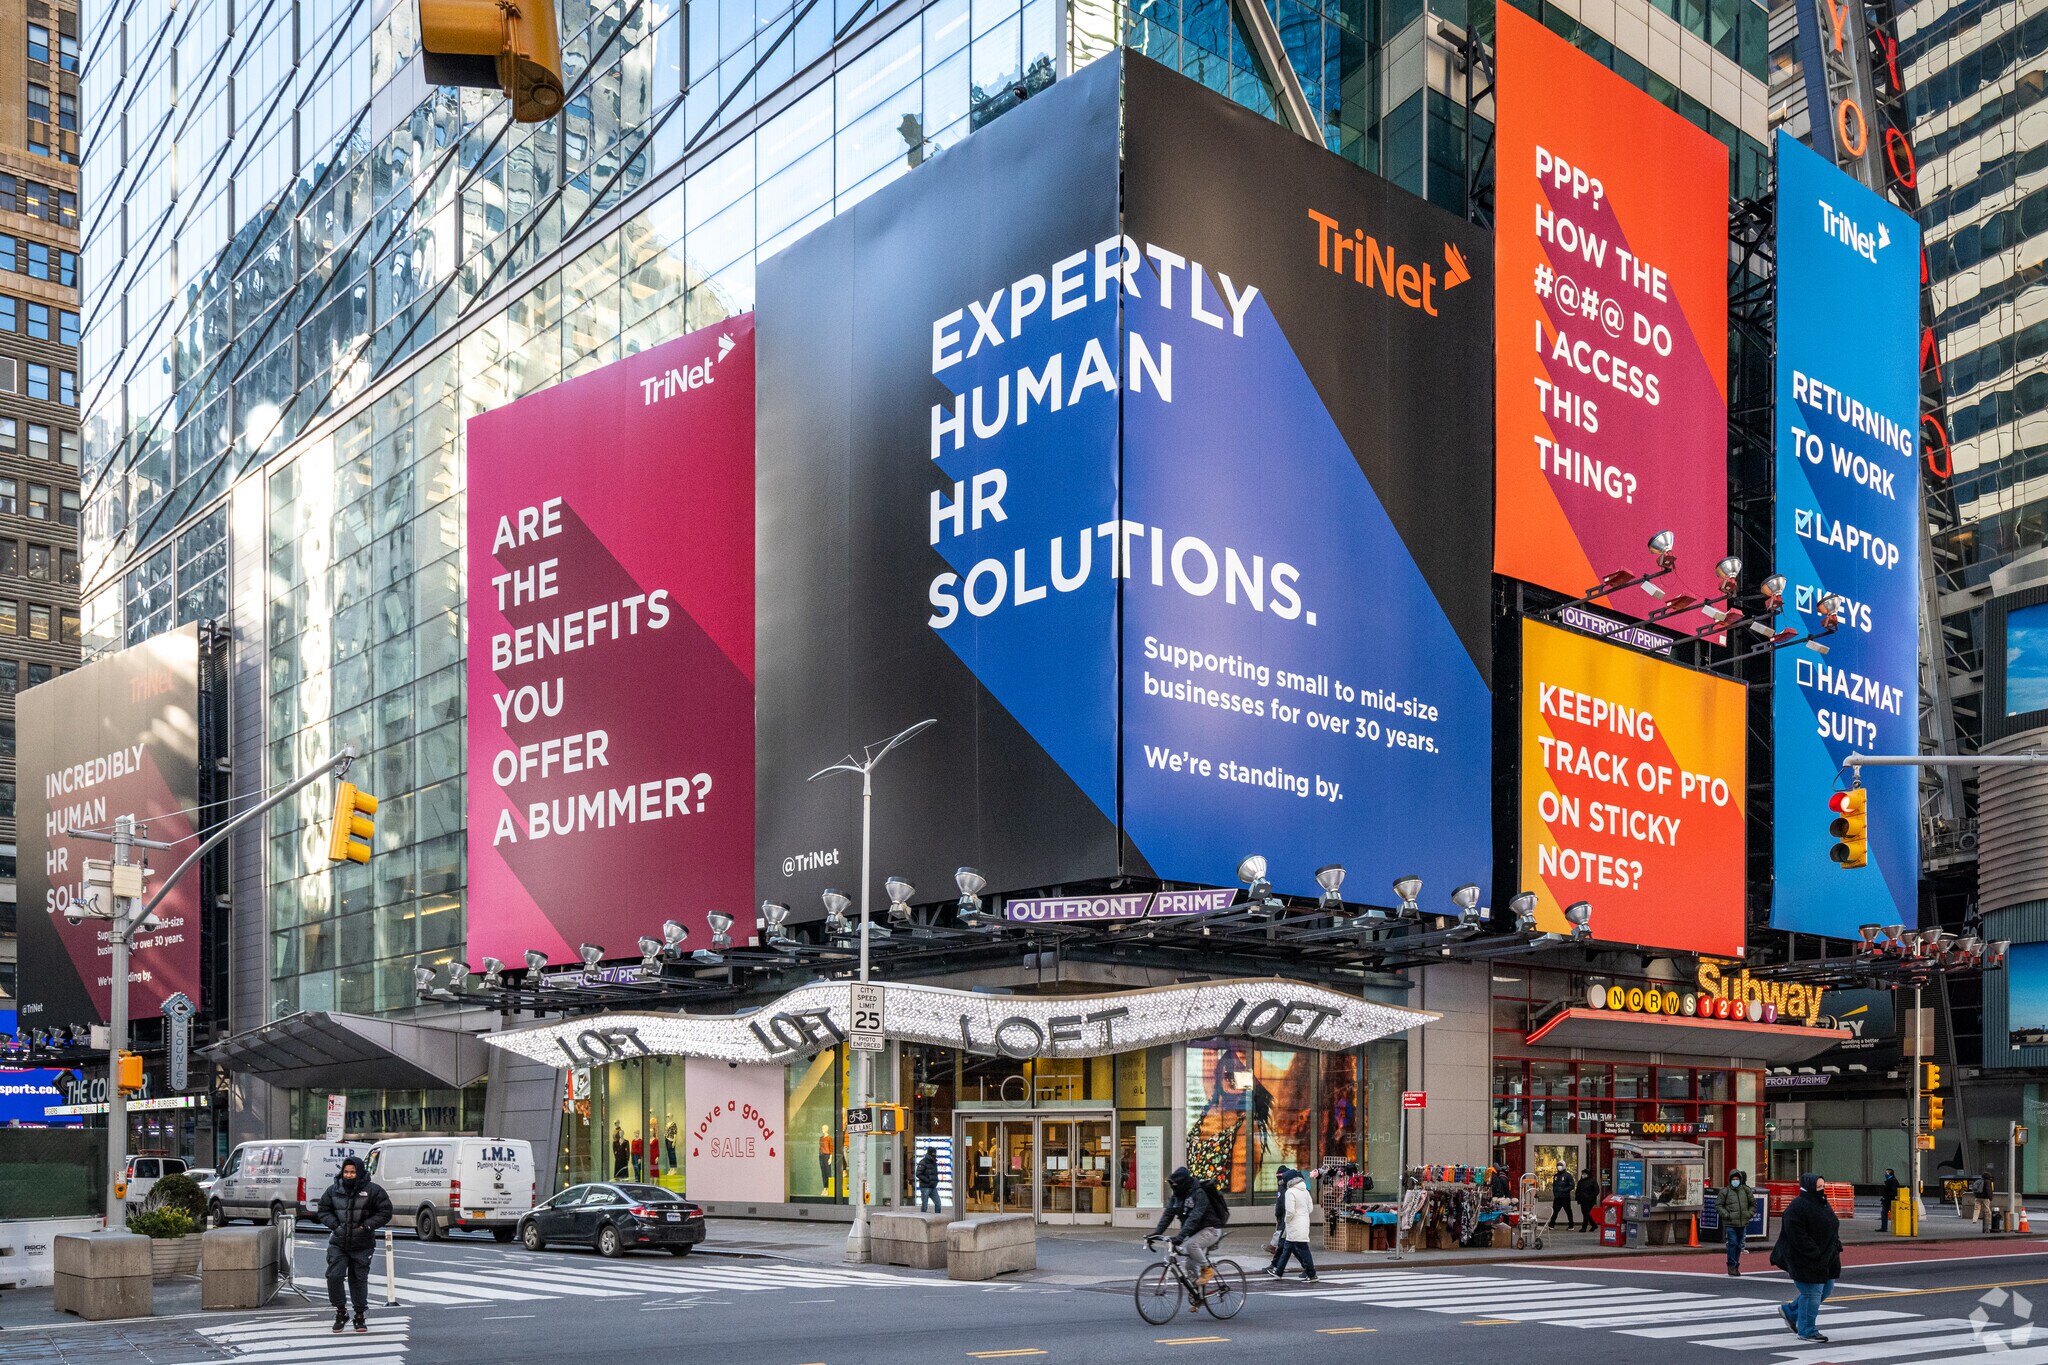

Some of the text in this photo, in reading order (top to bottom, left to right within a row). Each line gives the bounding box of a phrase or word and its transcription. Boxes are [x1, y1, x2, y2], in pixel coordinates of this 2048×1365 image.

[1536, 145, 1604, 211] PPP?
[1535, 203, 1667, 303] HOW THE
[1818, 199, 1877, 264] TriNet
[1308, 208, 1438, 317] TriNet
[931, 234, 1259, 374] EXPERTLY
[1534, 263, 1672, 357] #@#@ DO
[640, 357, 714, 405] TriNet
[1535, 320, 1660, 405] I ACCESS
[931, 331, 1172, 460] HUMAN
[1534, 377, 1598, 433] THIS
[1792, 370, 1912, 457] RETURNING
[1534, 435, 1637, 504] THING?
[1791, 426, 1895, 501] TO WORK
[492, 496, 562, 555] ARE
[930, 468, 1008, 545] HR
[1816, 512, 1899, 570] LAPTOP
[492, 558, 558, 611] THE
[927, 519, 1317, 629] SOLUTIONS.
[492, 589, 670, 671] BENEFITS
[1638, 633, 1669, 652] PRIME
[493, 677, 563, 727] YOU
[1144, 636, 1438, 722] Supporting small to mid-size
[1818, 663, 1903, 716] HAZMAT
[1144, 672, 1439, 754] businesses for over 30 years.
[1539, 682, 1654, 741] KEEPING
[1817, 708, 1877, 750] SUIT?
[46, 743, 144, 799] INCREDIBLY
[492, 729, 609, 786] OFFER
[1144, 745, 1344, 802] We're standing by.
[1538, 735, 1729, 806] TRACK OF PTO
[46, 797, 106, 837] HUMAN
[493, 772, 712, 846] A BUMMER?
[1538, 791, 1681, 846] ON STICKY
[46, 847, 68, 876] HR
[782, 848, 839, 877] @TriNet
[1538, 843, 1643, 890] NOTES?
[1012, 894, 1226, 920] OUTFRONT PRIME
[140, 939, 153, 948] over
[155, 935, 163, 946] 30
[165, 934, 184, 947] years.
[143, 970, 152, 982] by.
[857, 994, 877, 1002] SPEED
[1698, 962, 1825, 1027] Subway
[22, 1003, 43, 1016] @TriNet
[749, 1007, 845, 1054] LOFT
[855, 1011, 880, 1030] 25
[1219, 999, 1342, 1043] LOFT
[1613, 990, 1622, 1006] N
[1632, 992, 1641, 1008] Q
[1651, 994, 1659, 1008] R
[1668, 997, 1679, 1014] W
[1686, 996, 1694, 1012] S
[1720, 1000, 1727, 1015] 2
[1736, 1001, 1743, 1016] 3
[1768, 1005, 1775, 1020] 7
[176, 1031, 185, 1086] COUNTER
[556, 1027, 650, 1068] LOFT
[959, 1007, 1129, 1059] LOFT
[67, 1079, 88, 1104] THE
[157, 1099, 178, 1108] BURGERS
[980, 1075, 1074, 1108] LOFT
[1766, 1076, 1827, 1086] FRONT PRIME
[694, 1100, 774, 1141] love a good
[711, 1137, 755, 1157] SALE
[414, 1166, 427, 1175] Plumbing
[430, 1167, 440, 1175] Heating
[422, 1148, 443, 1165] I.M.P.
[477, 1162, 493, 1171] Plumbing
[481, 1147, 516, 1162] I.M.P.
